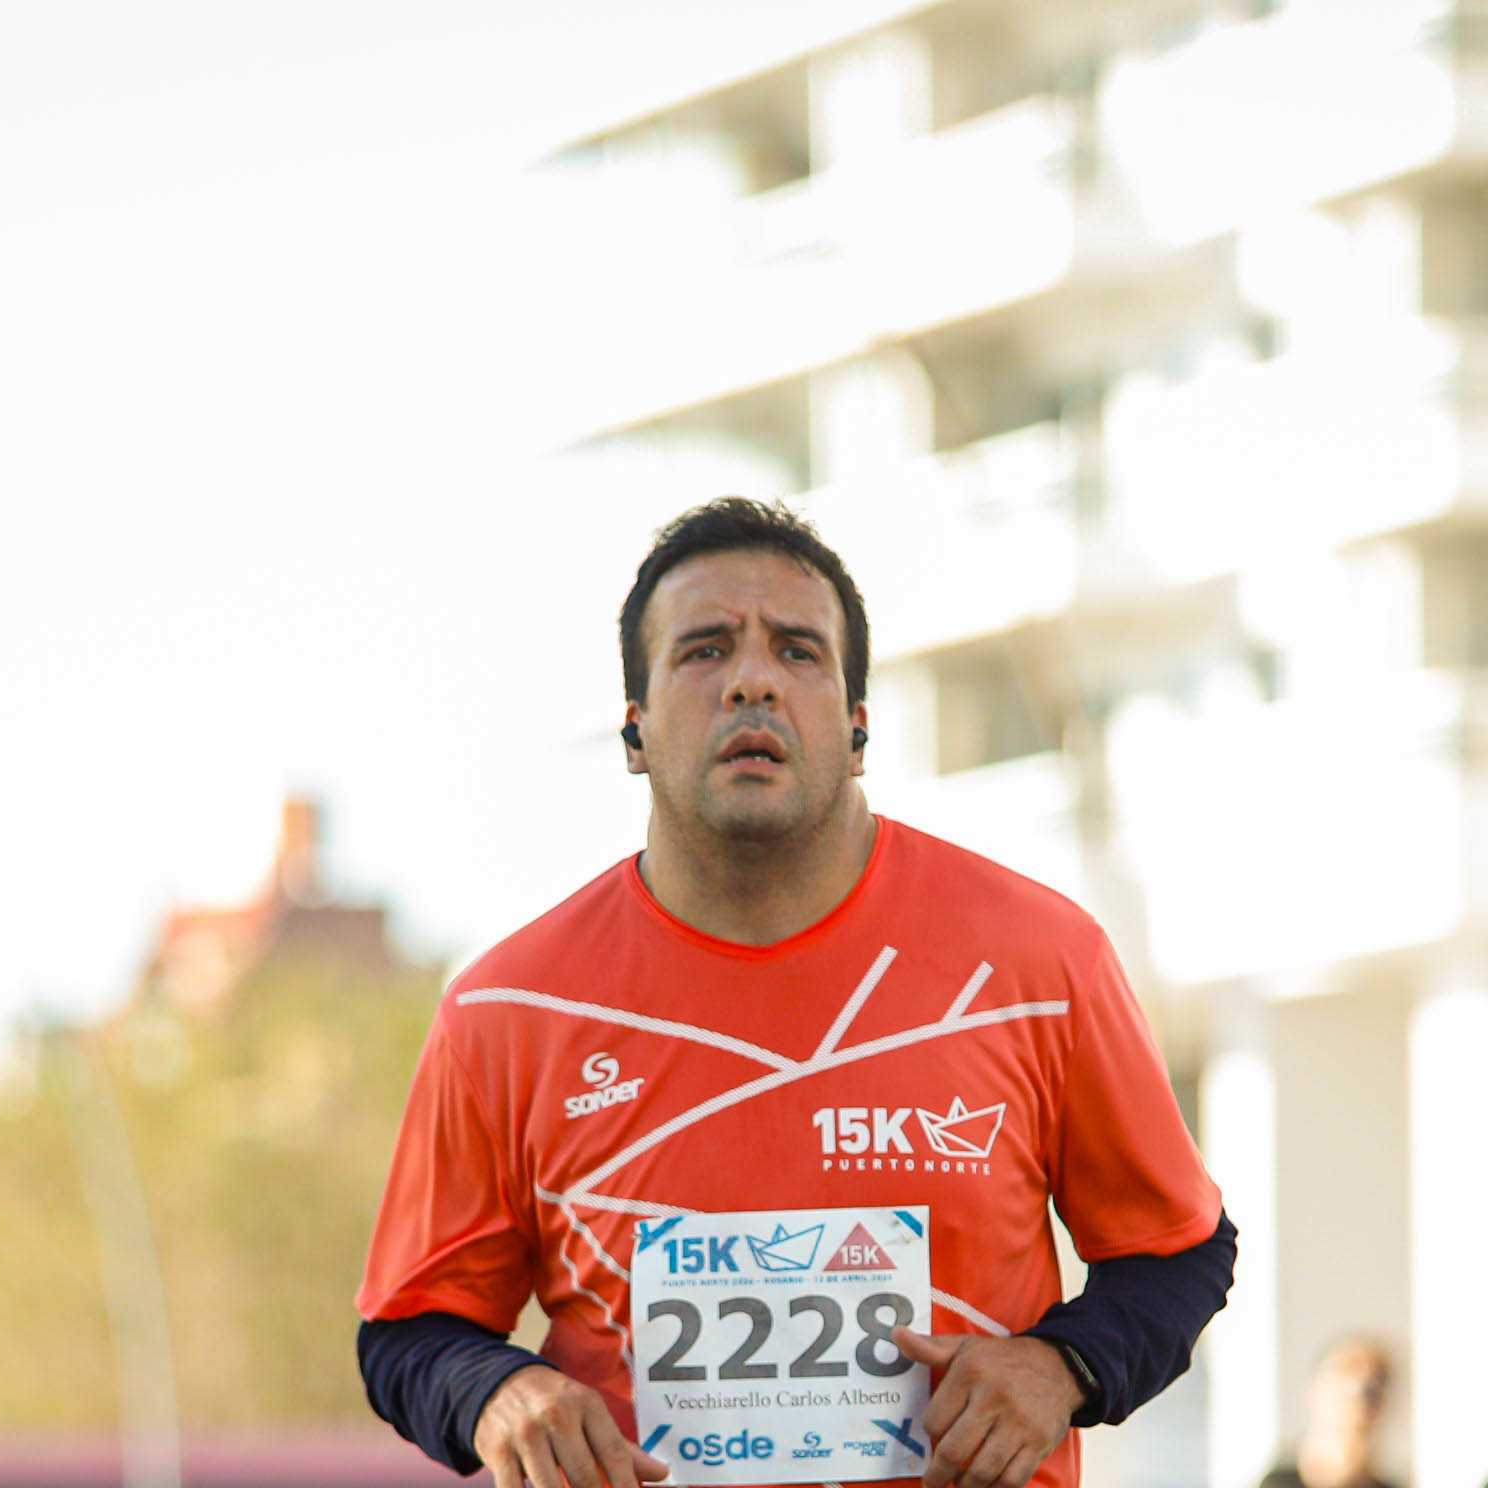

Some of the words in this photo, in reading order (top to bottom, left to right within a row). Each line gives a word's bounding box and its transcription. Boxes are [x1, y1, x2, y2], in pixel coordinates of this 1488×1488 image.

[812, 1107, 914, 1154] 15K
[823, 1158, 915, 1172] PUERTO
[924, 1159, 991, 1176] NORTE
[663, 1235, 740, 1274] 15K
[840, 1245, 881, 1266] 15K
[647, 1292, 915, 1382] 2228
[664, 1392, 771, 1409] Vecchiarello
[776, 1391, 832, 1407] Carlos
[838, 1389, 901, 1406] Alberto
[678, 1429, 774, 1464] osde
